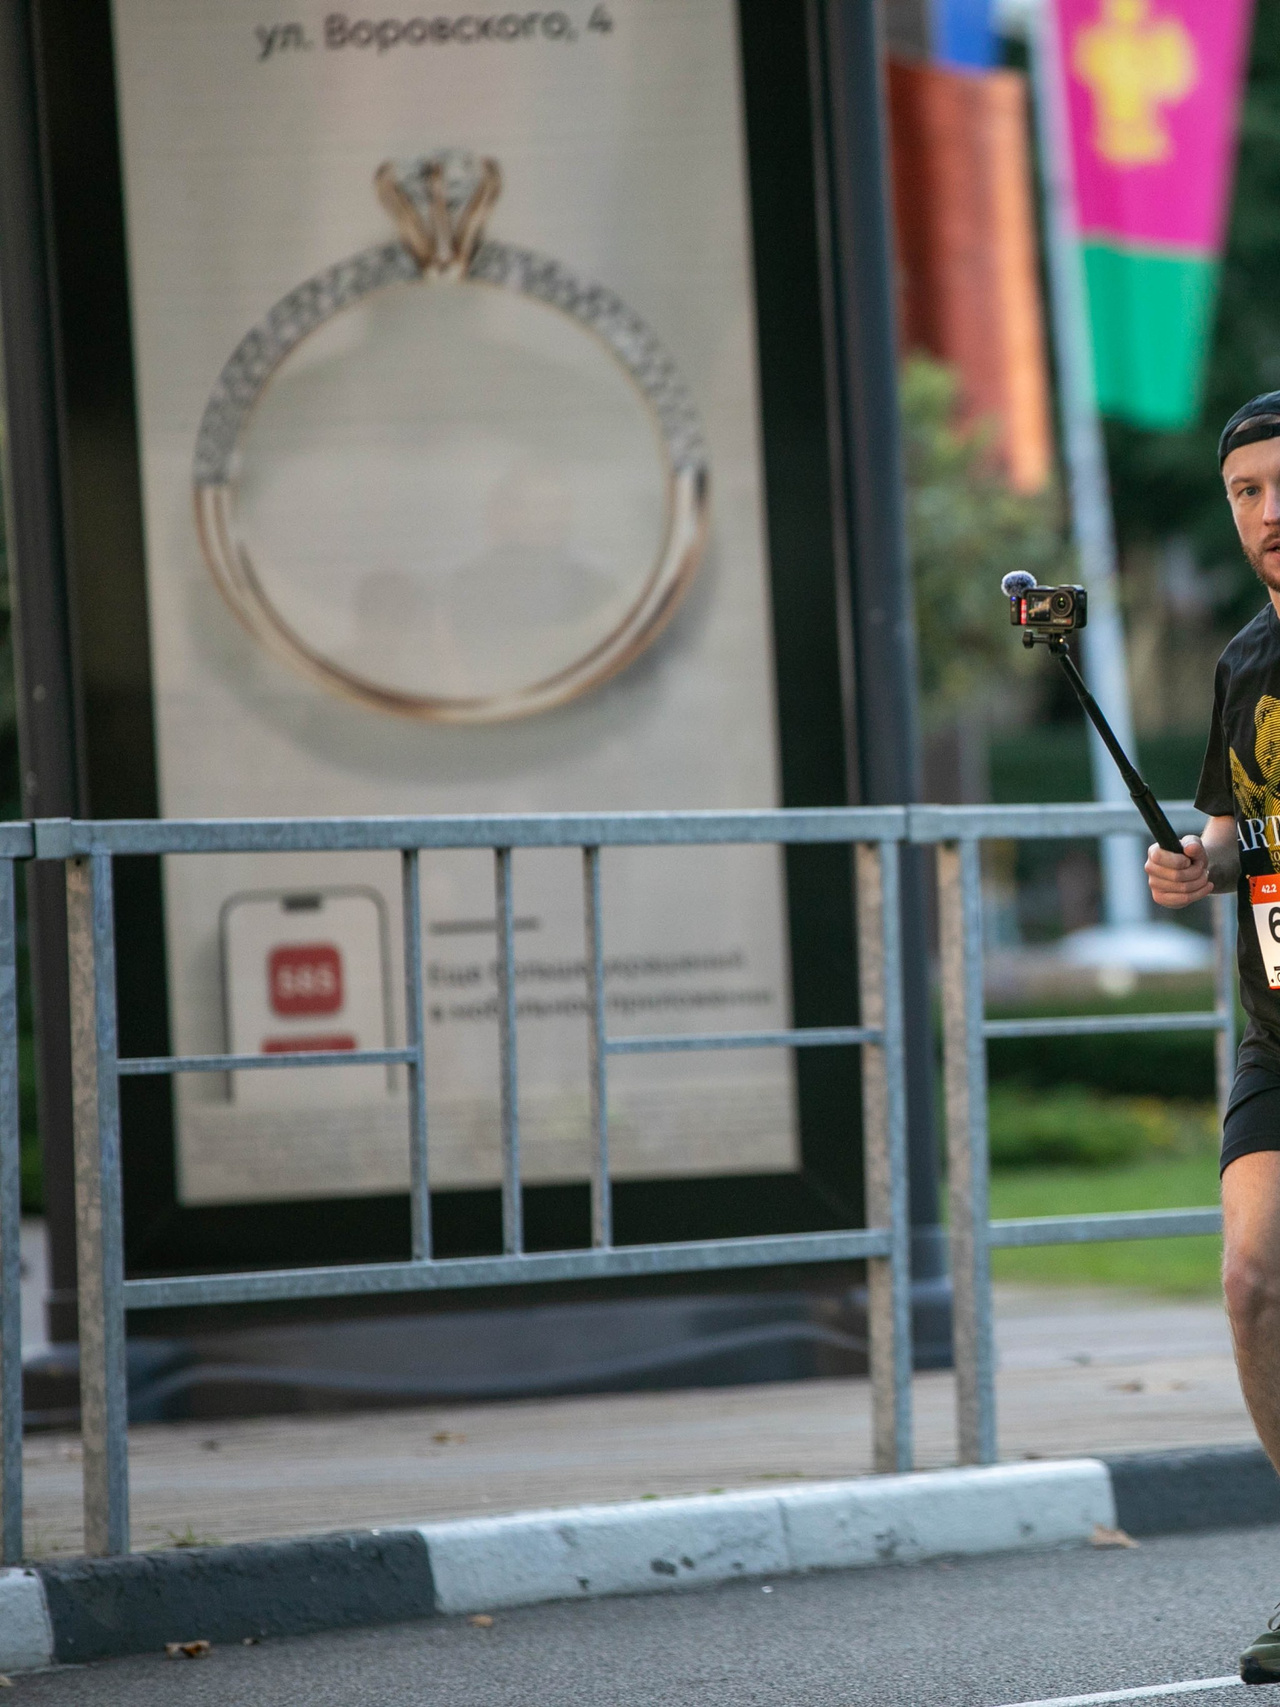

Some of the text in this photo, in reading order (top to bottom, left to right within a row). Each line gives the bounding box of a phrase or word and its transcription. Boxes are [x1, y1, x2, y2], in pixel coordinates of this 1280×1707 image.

[254, 4, 614, 62] ул. Воровского, 4
[1261, 883, 1278, 894] 42.2
